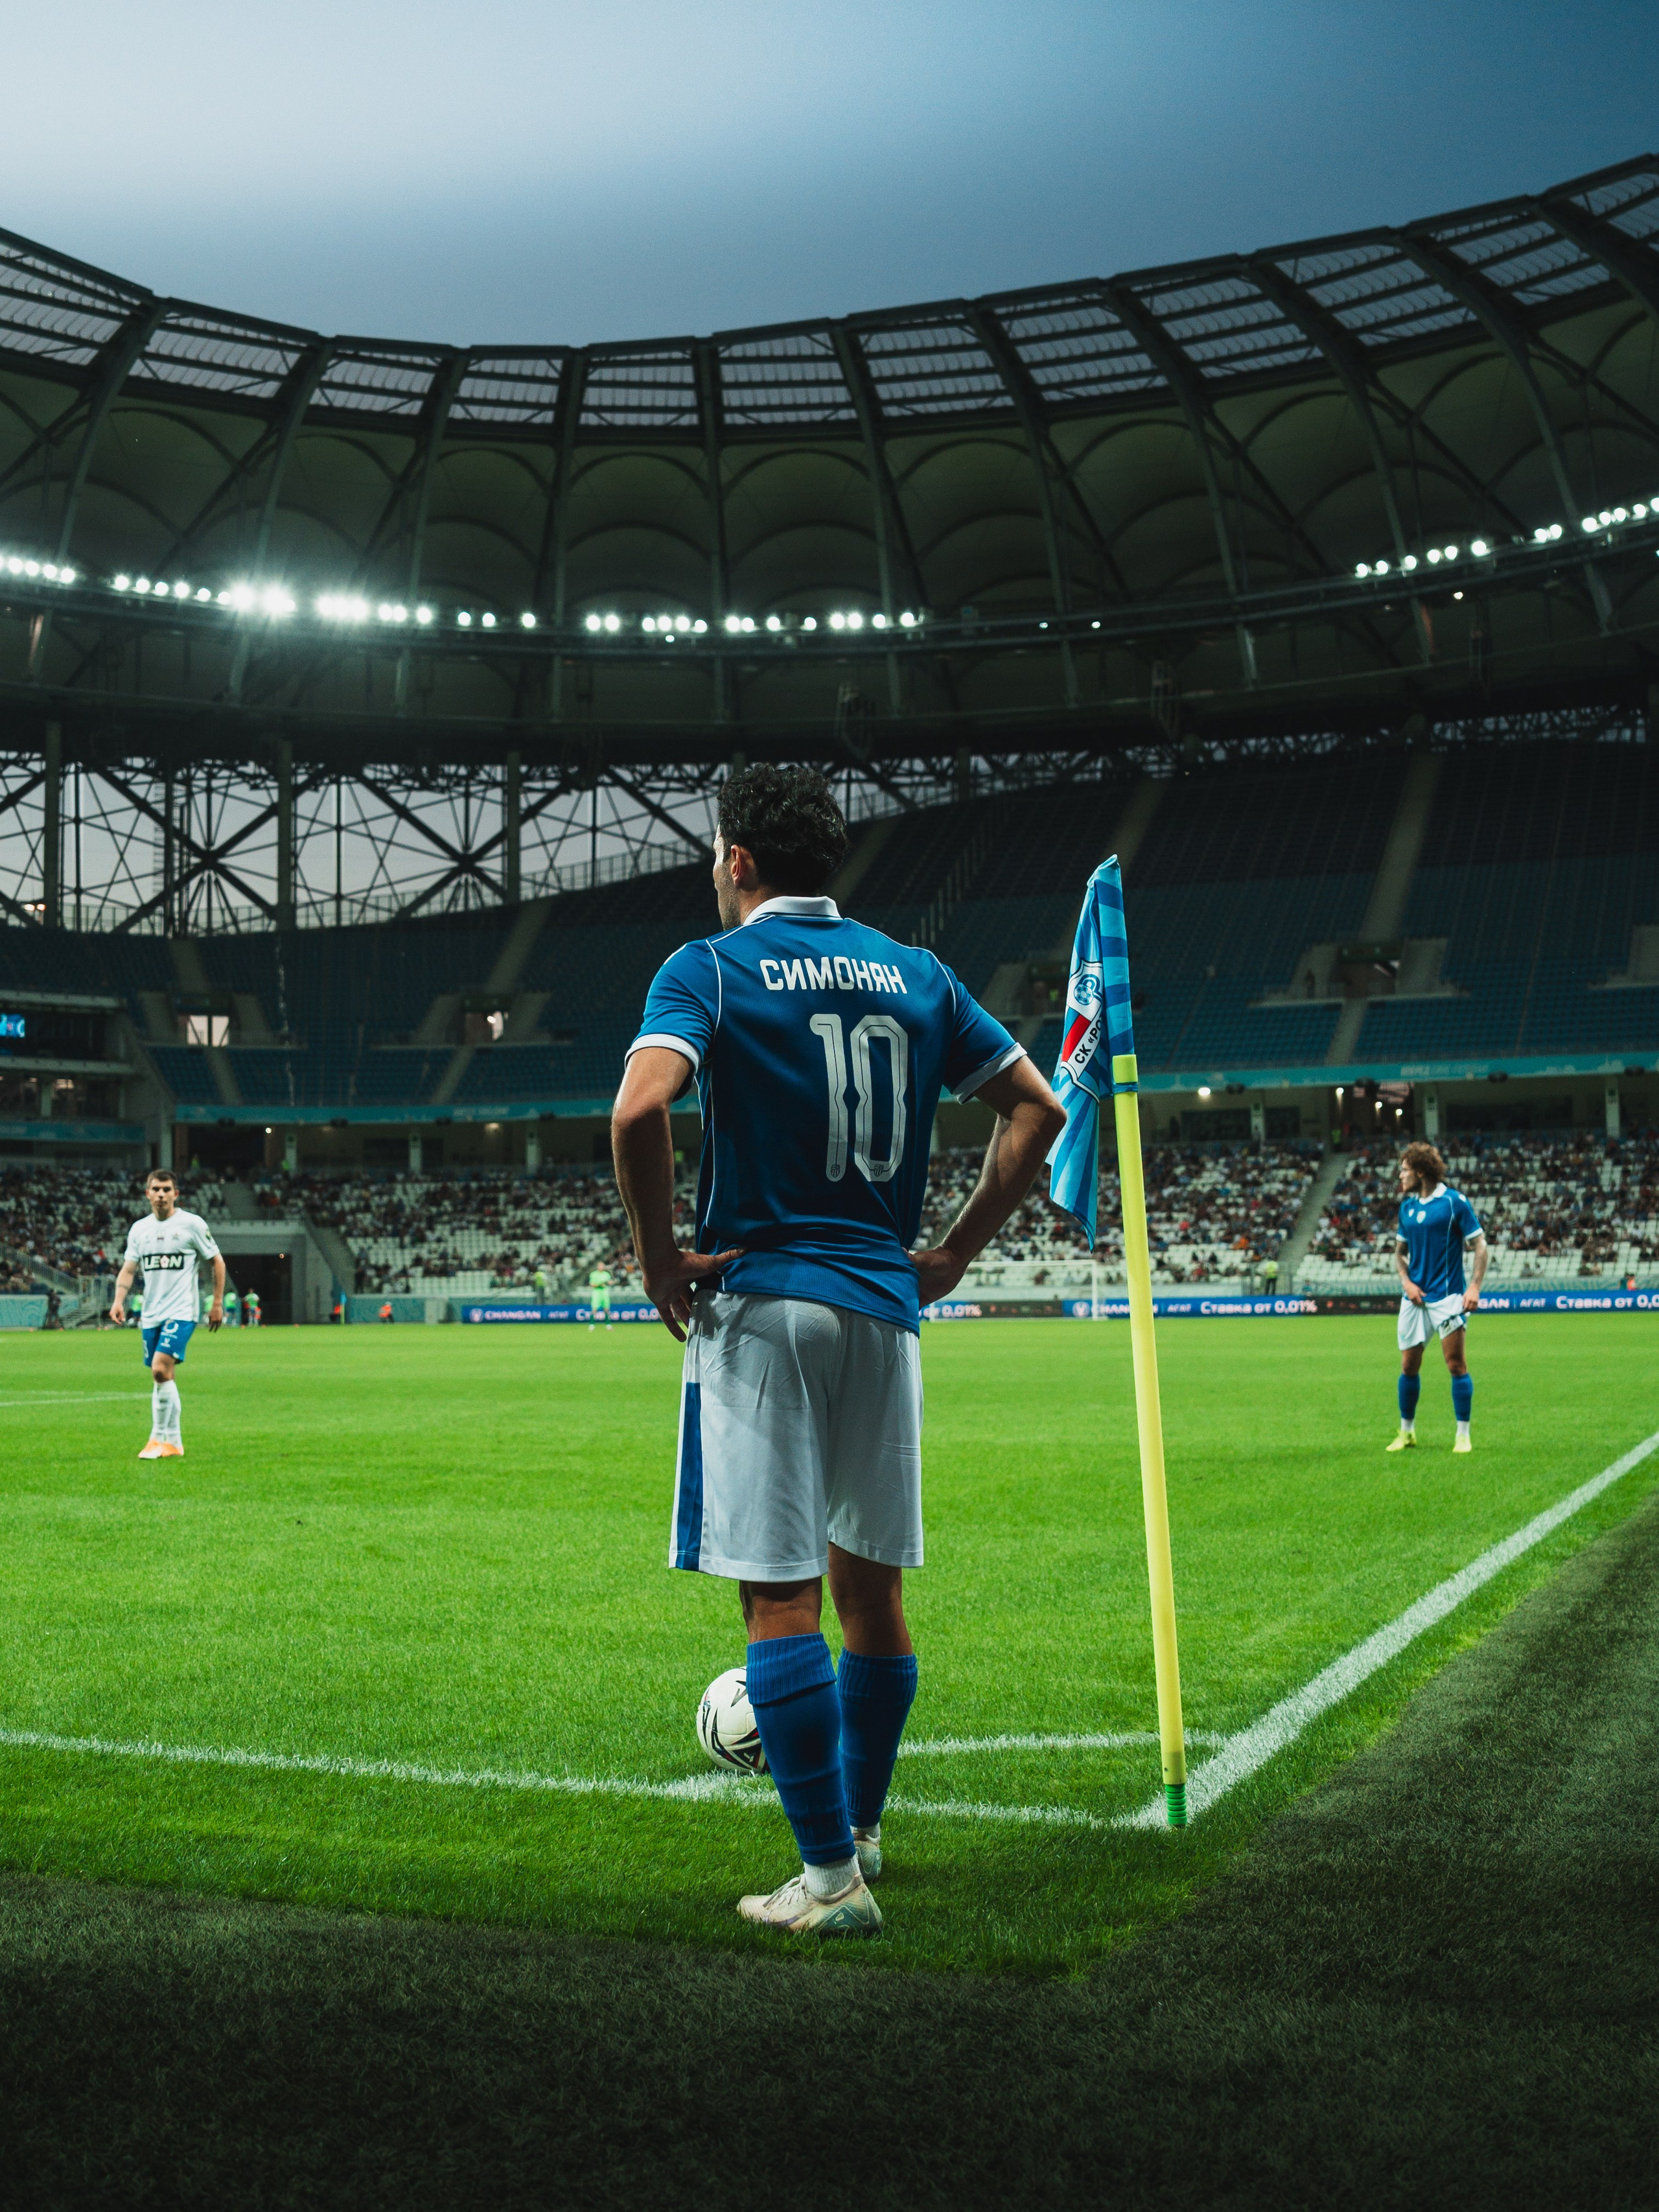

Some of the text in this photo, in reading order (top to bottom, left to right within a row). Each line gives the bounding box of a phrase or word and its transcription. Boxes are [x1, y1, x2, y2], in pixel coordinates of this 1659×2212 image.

[760, 956, 908, 994] СИМОНЯН
[1074, 1014, 1102, 1064] СК «РО
[809, 1013, 909, 1182] 10
[1201, 1299, 1318, 1314] Ставка от 0,01%
[1556, 1294, 1659, 1309] Ставка от 0,0
[638, 1308, 659, 1321] 0,0
[942, 1304, 982, 1318] 0,01%
